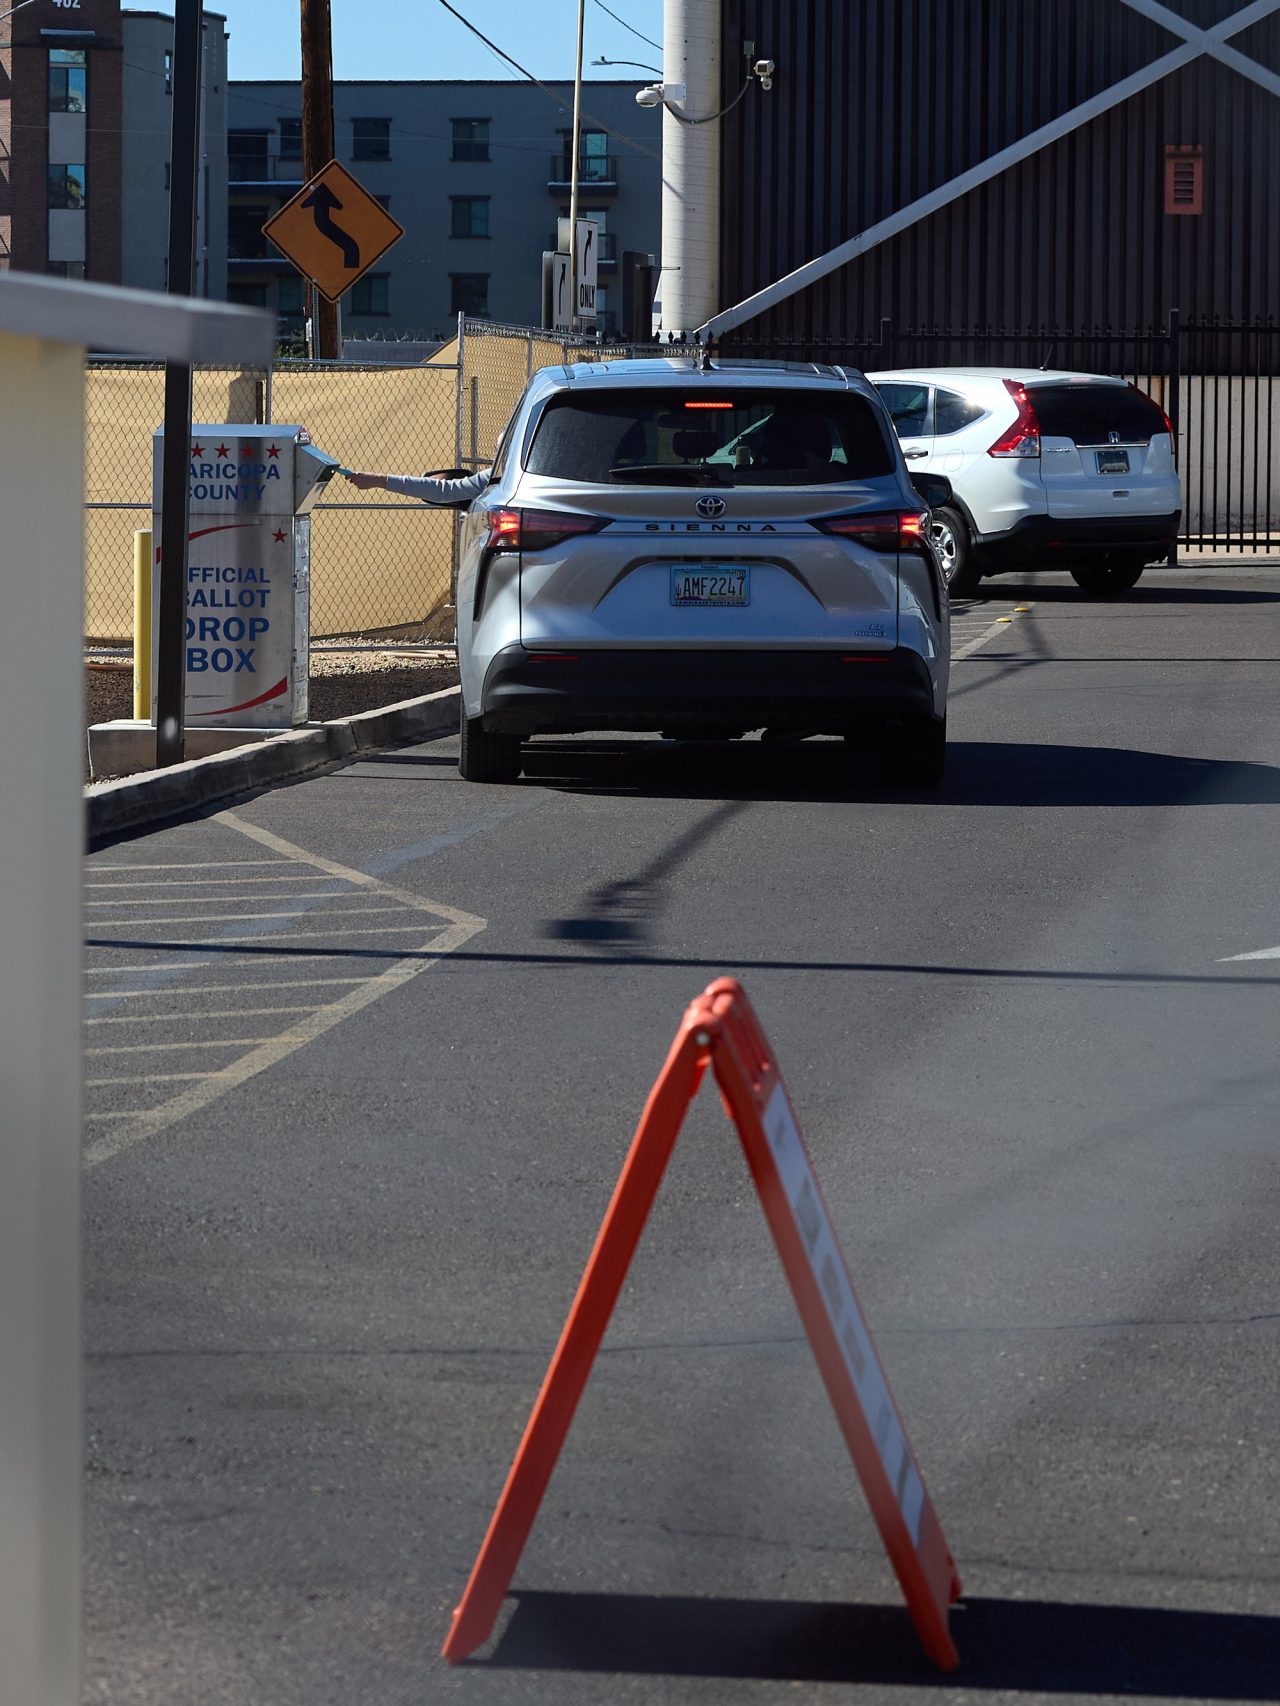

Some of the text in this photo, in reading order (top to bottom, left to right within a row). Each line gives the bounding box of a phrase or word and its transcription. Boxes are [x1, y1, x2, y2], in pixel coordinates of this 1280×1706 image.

[580, 283, 596, 308] ONLY
[189, 463, 281, 480] ARICOPA
[645, 523, 777, 532] SIENNA
[188, 567, 271, 583] FFICIAL
[683, 577, 745, 596] AMF2247
[186, 647, 257, 673] BOX
